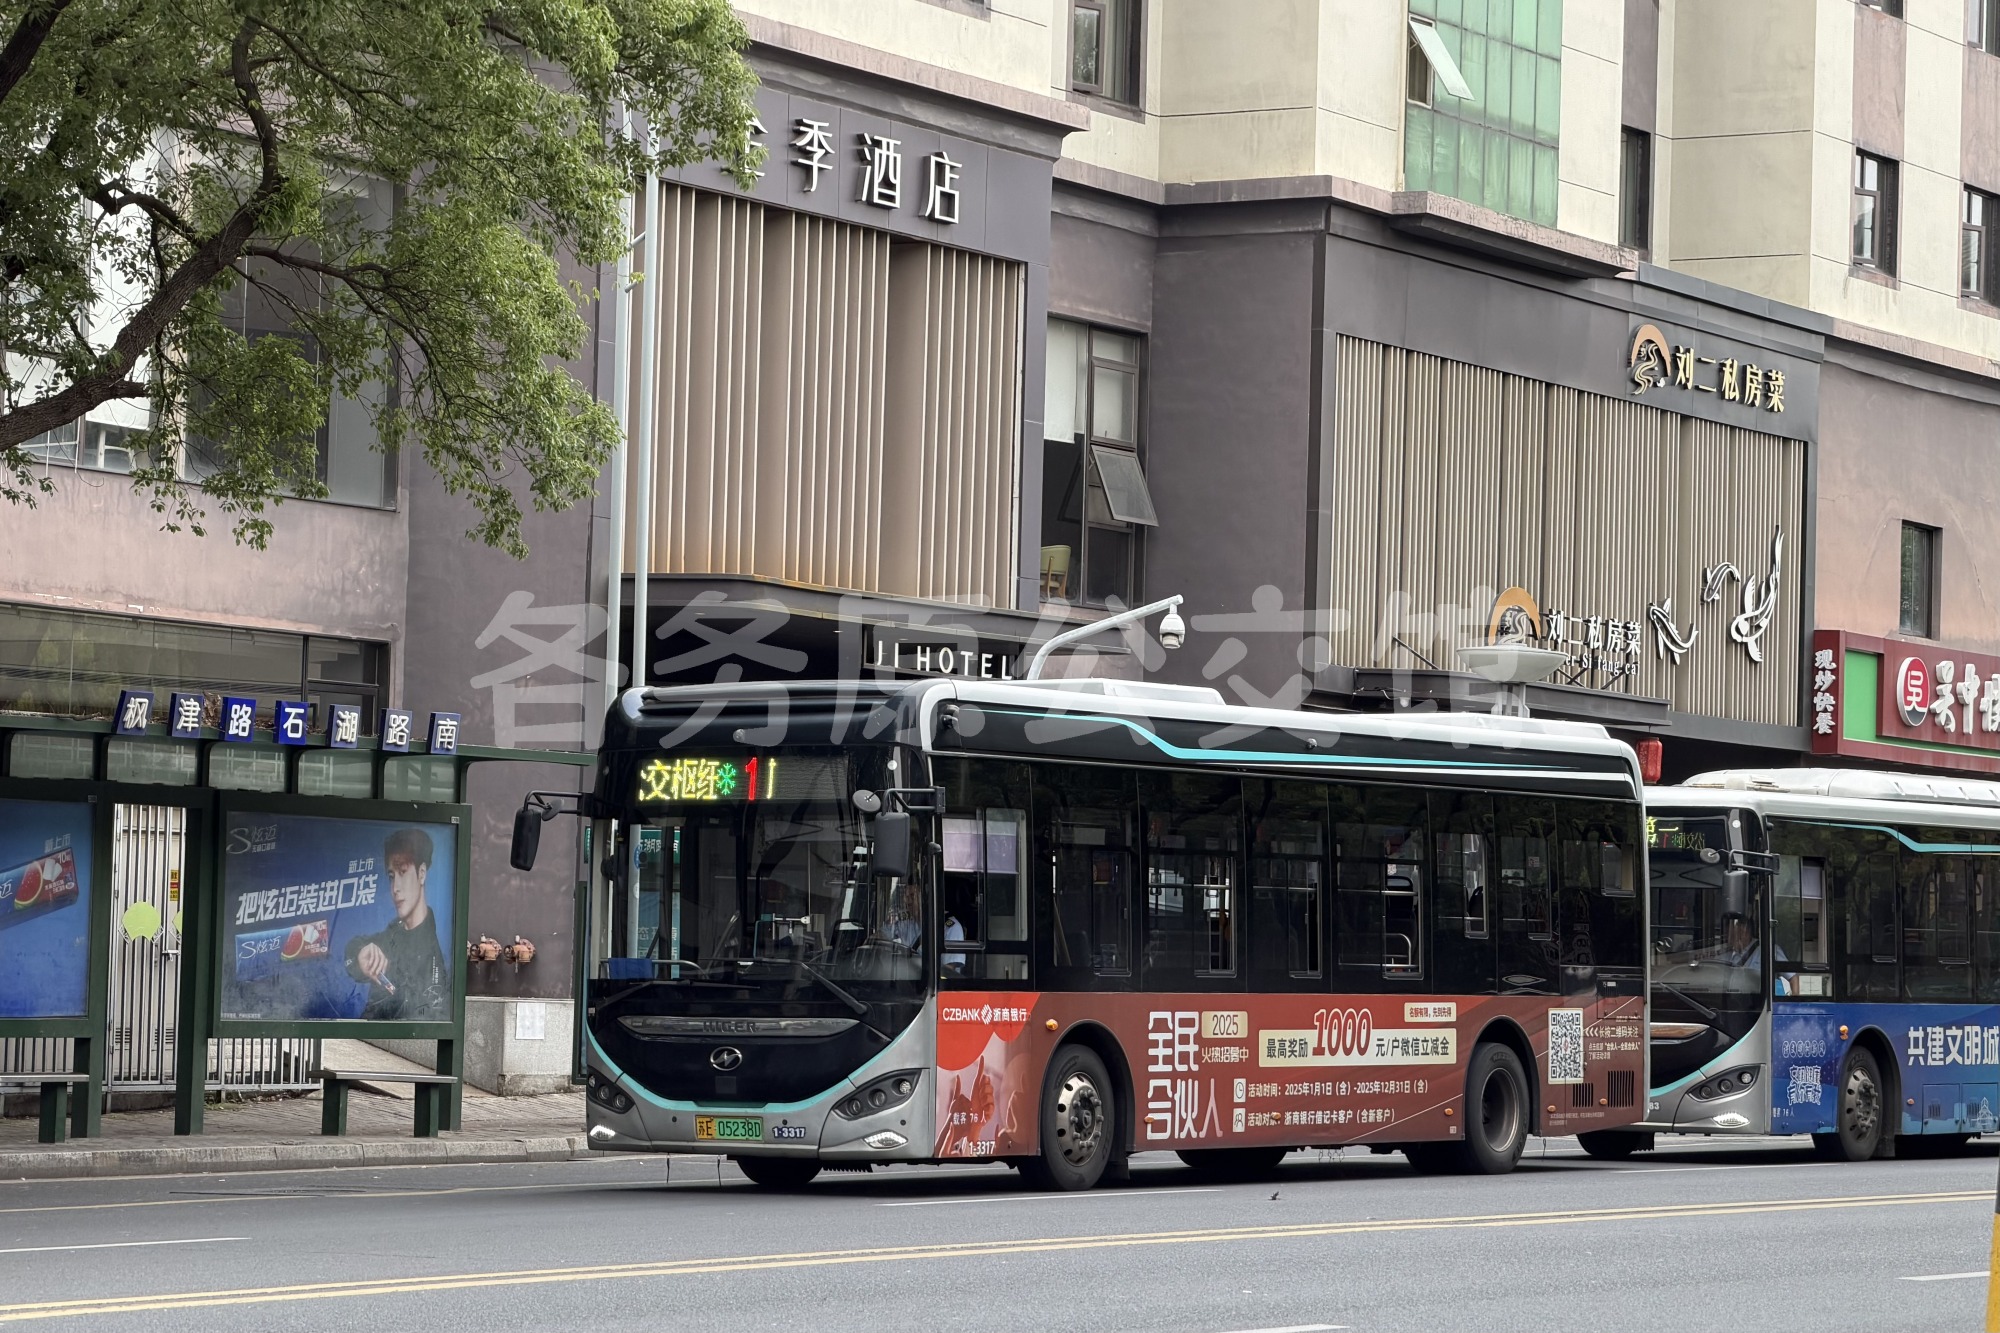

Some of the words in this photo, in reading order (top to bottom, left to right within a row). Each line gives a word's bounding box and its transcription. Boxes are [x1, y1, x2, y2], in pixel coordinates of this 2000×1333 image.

[1675, 345, 1785, 412] 刘二私房菜
[1548, 609, 1641, 656] 刘二私房菜
[876, 640, 899, 668] JI
[917, 645, 1012, 680] HOTEL
[1813, 649, 1836, 735] 现炒快餐
[122, 697, 459, 749] 枫津路石湖路南
[638, 758, 719, 801] 交枢纽
[348, 858, 374, 874] 新上市
[235, 874, 378, 925] 把炫迈装进口袋
[943, 1008, 980, 1022] CZBANK
[993, 1008, 1027, 1022] 浙商银行
[1212, 1014, 1239, 1036] 2025
[1266, 1038, 1308, 1059] 最高奖励
[1312, 1008, 1373, 1057] 1000
[1375, 1036, 1450, 1057] 元/户微信立减金
[1148, 1011, 1199, 1072] 全民
[1201, 1047, 1249, 1063] 火热招募中
[1907, 1026, 2000, 1066] 共建文明城
[1147, 1078, 1223, 1140] 合伙人
